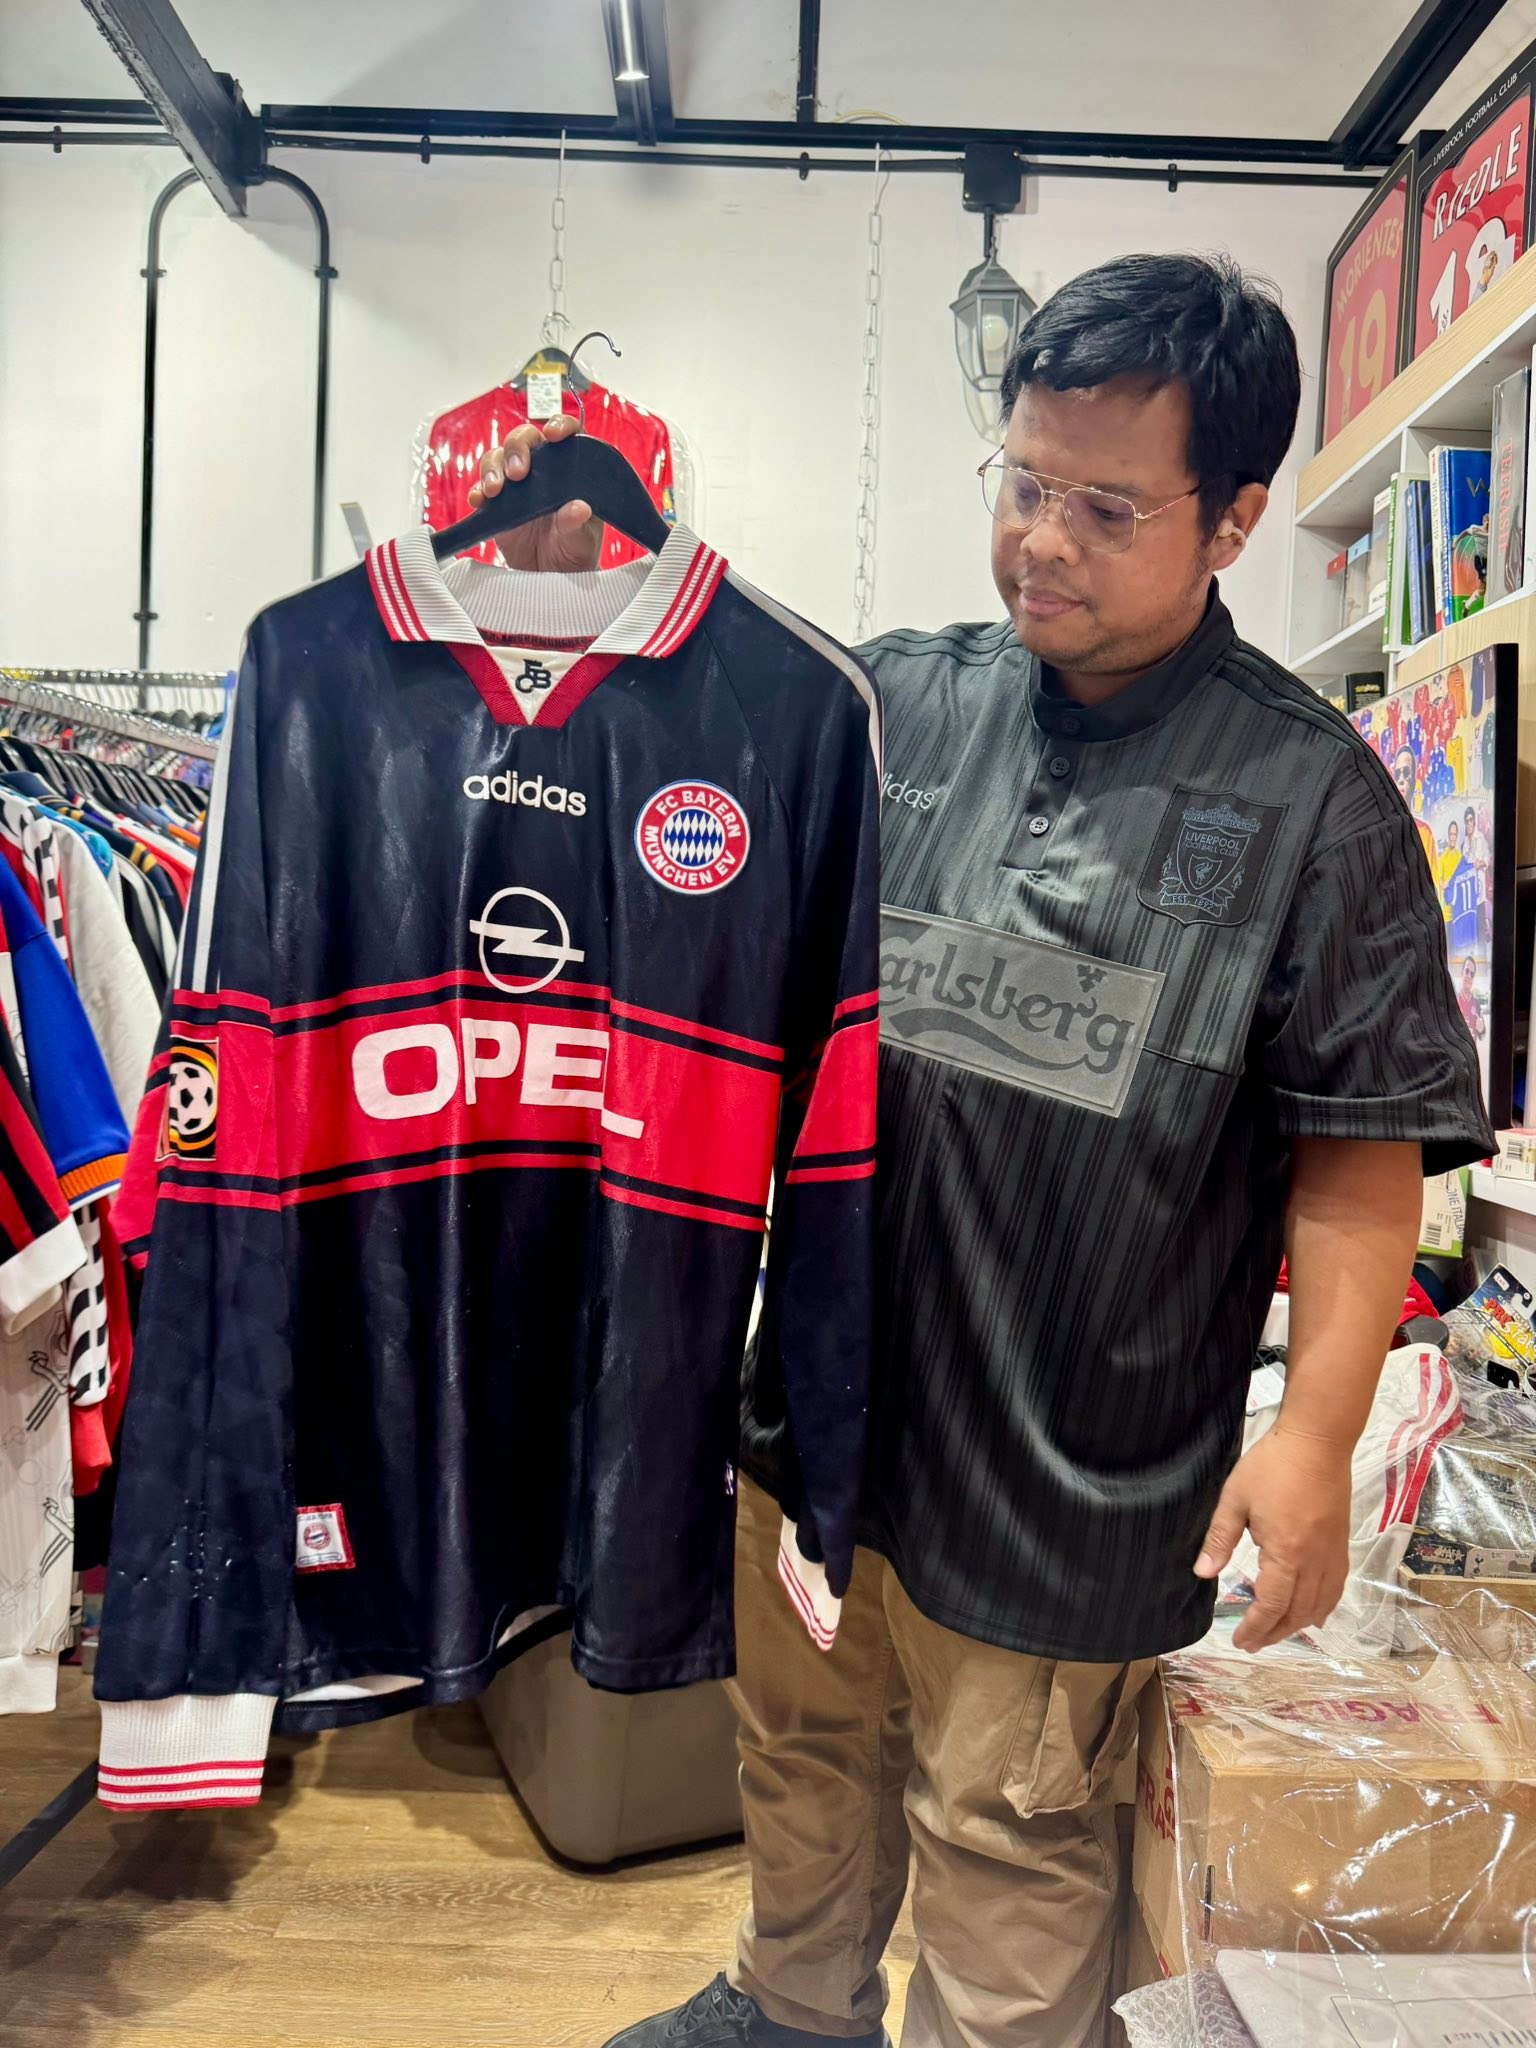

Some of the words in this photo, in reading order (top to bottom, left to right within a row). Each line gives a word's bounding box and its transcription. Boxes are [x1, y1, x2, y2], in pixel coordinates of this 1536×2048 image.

[1433, 128, 1464, 166] LIVERPOOL
[1465, 93, 1498, 132] FOOTBALL
[1499, 72, 1518, 97] CLUB
[1432, 121, 1523, 241] RIEDLE
[1336, 216, 1404, 323] MORIENTES
[1338, 289, 1387, 431] 19
[463, 770, 587, 817] adidas
[655, 794, 679, 816] FC
[681, 790, 742, 838] BAYERN
[882, 773, 935, 810] idas
[1182, 841, 1218, 854] FOOTBALL
[1219, 848, 1239, 858] CLUB
[1185, 831, 1240, 850] LIVERPOOL
[1172, 895, 1191, 905] EST.
[1193, 898, 1214, 911] 1892
[351, 1017, 645, 1140] OPEL
